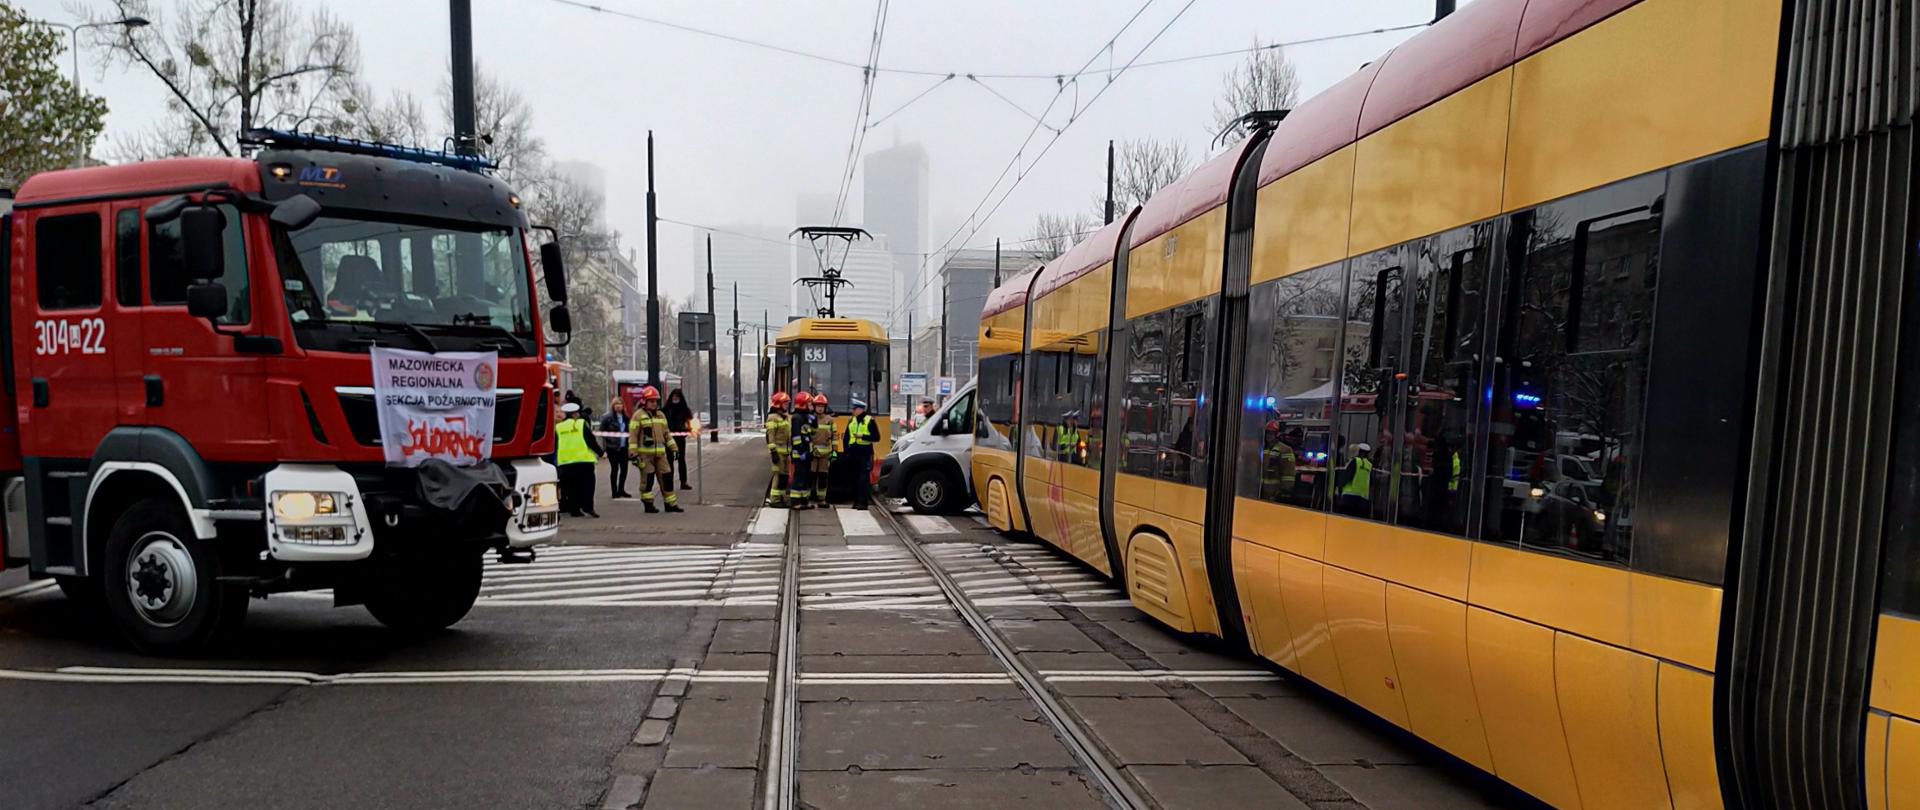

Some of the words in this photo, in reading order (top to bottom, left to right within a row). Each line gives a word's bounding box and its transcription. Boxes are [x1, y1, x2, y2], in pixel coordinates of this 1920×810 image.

[34, 319, 69, 355] 304
[81, 318, 106, 354] 22
[806, 346, 824, 361] 33
[388, 359, 465, 372] MAZOWIECKA
[391, 376, 464, 389] REGIONALNA
[385, 395, 426, 407] SEKCJA
